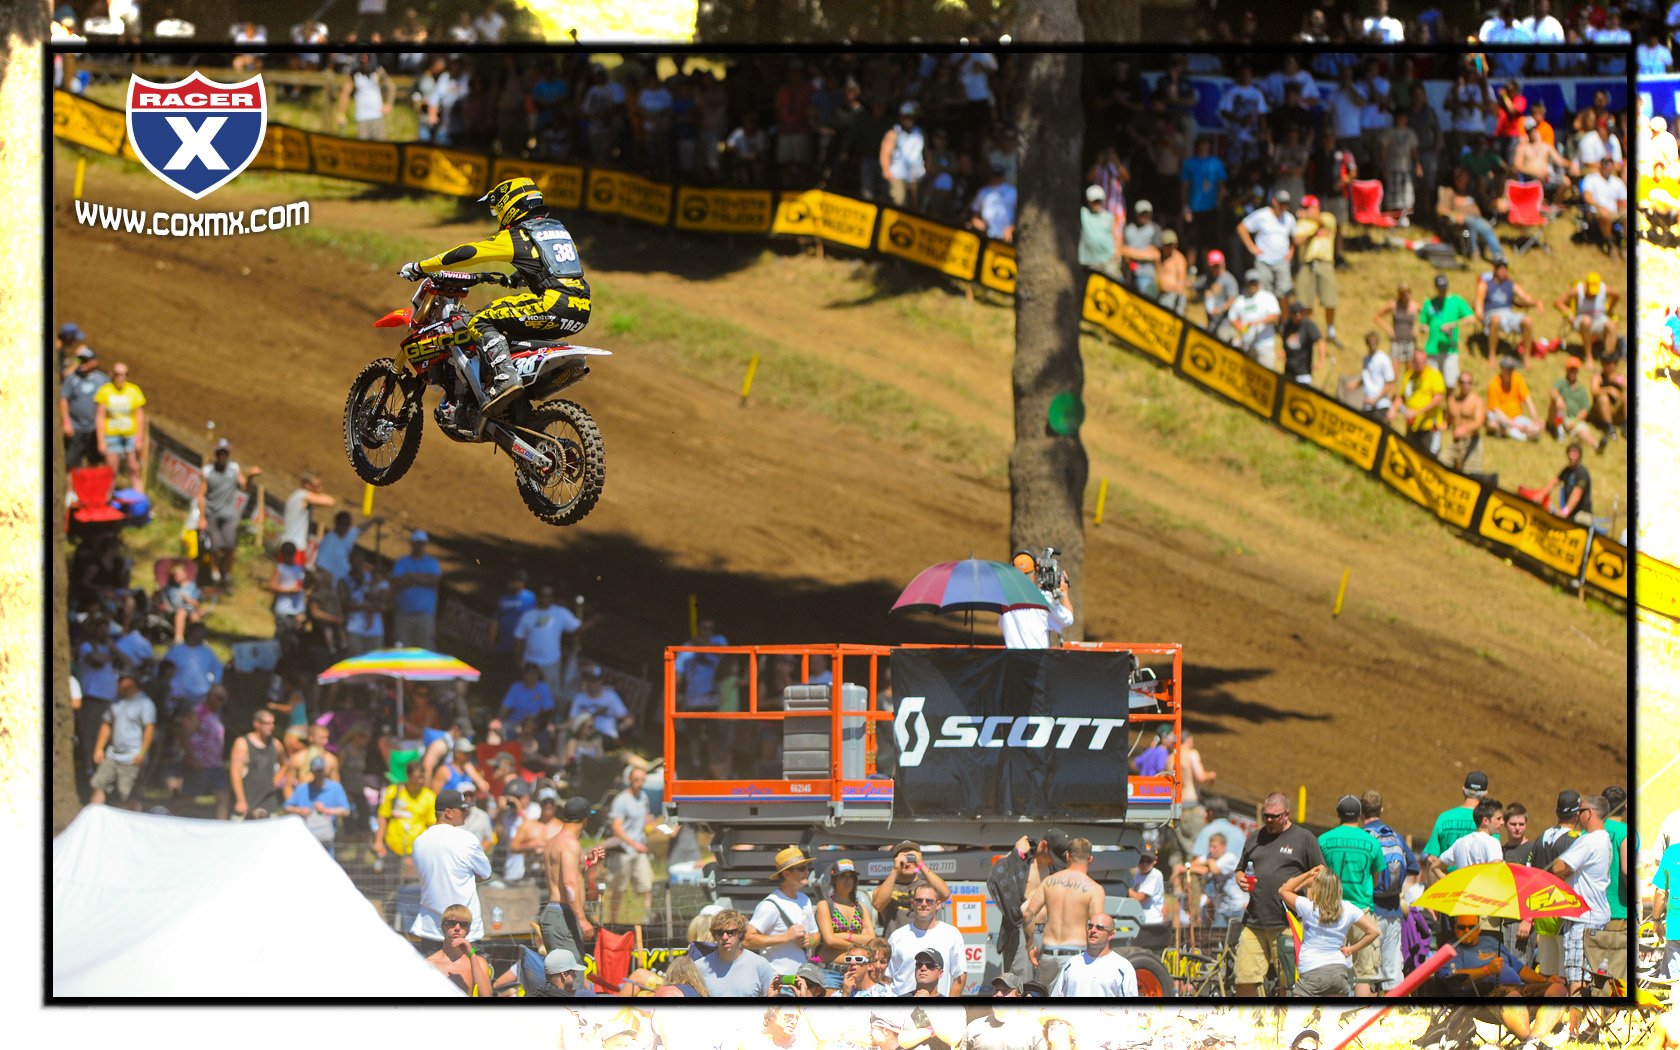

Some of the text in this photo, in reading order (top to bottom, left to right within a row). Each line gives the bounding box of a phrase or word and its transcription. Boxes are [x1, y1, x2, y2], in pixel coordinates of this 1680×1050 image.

[552, 243, 576, 263] 38
[560, 318, 586, 333] TREY
[404, 330, 472, 357] GEICO
[515, 356, 535, 375] 38
[1320, 407, 1375, 443] TOYOTA
[1318, 423, 1370, 459] TRUCKS
[933, 716, 1126, 751] SCOTT
[960, 886, 979, 894] 8841
[965, 948, 983, 961] SC
